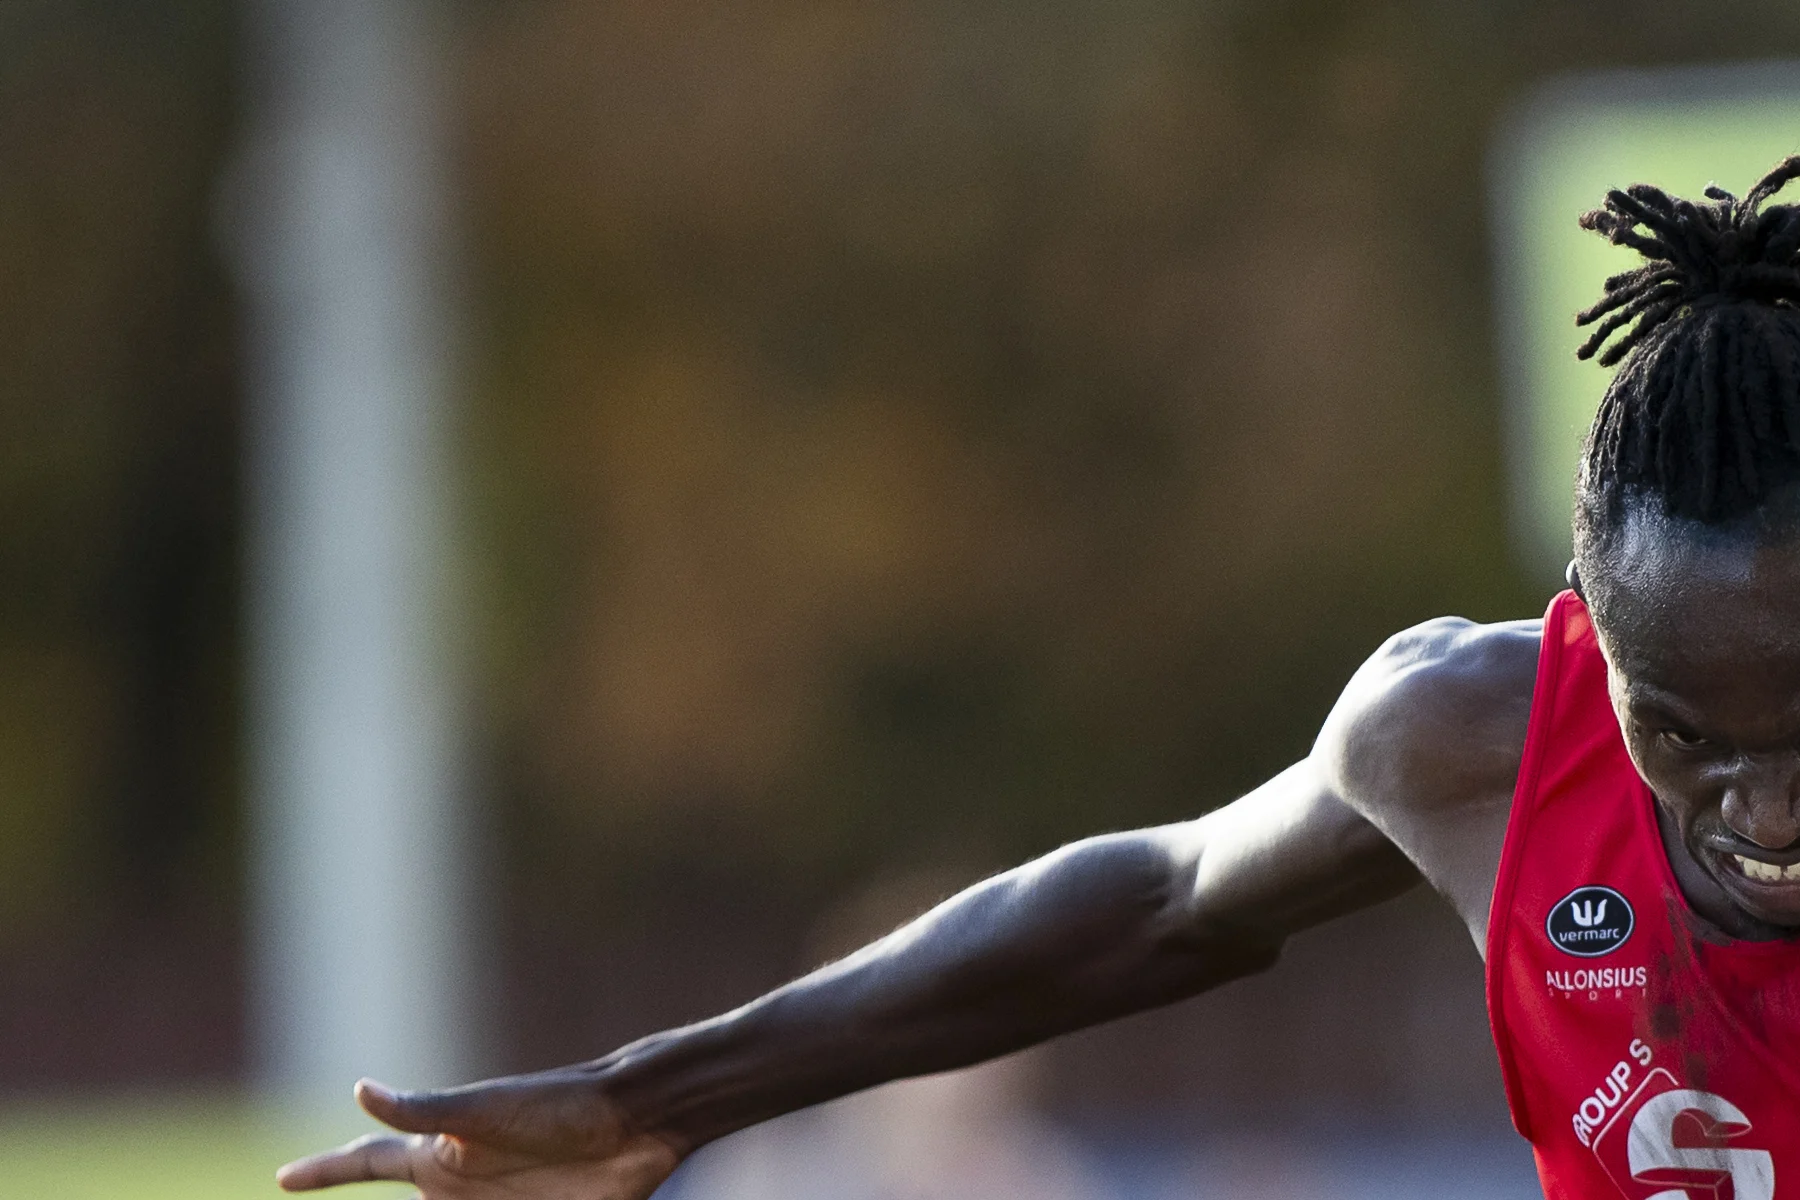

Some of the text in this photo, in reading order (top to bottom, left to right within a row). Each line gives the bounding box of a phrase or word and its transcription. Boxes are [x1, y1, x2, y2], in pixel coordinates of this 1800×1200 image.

[1559, 927, 1620, 942] vermarc
[1546, 966, 1647, 991] ALLONSIUS
[1629, 1038, 1653, 1066] S
